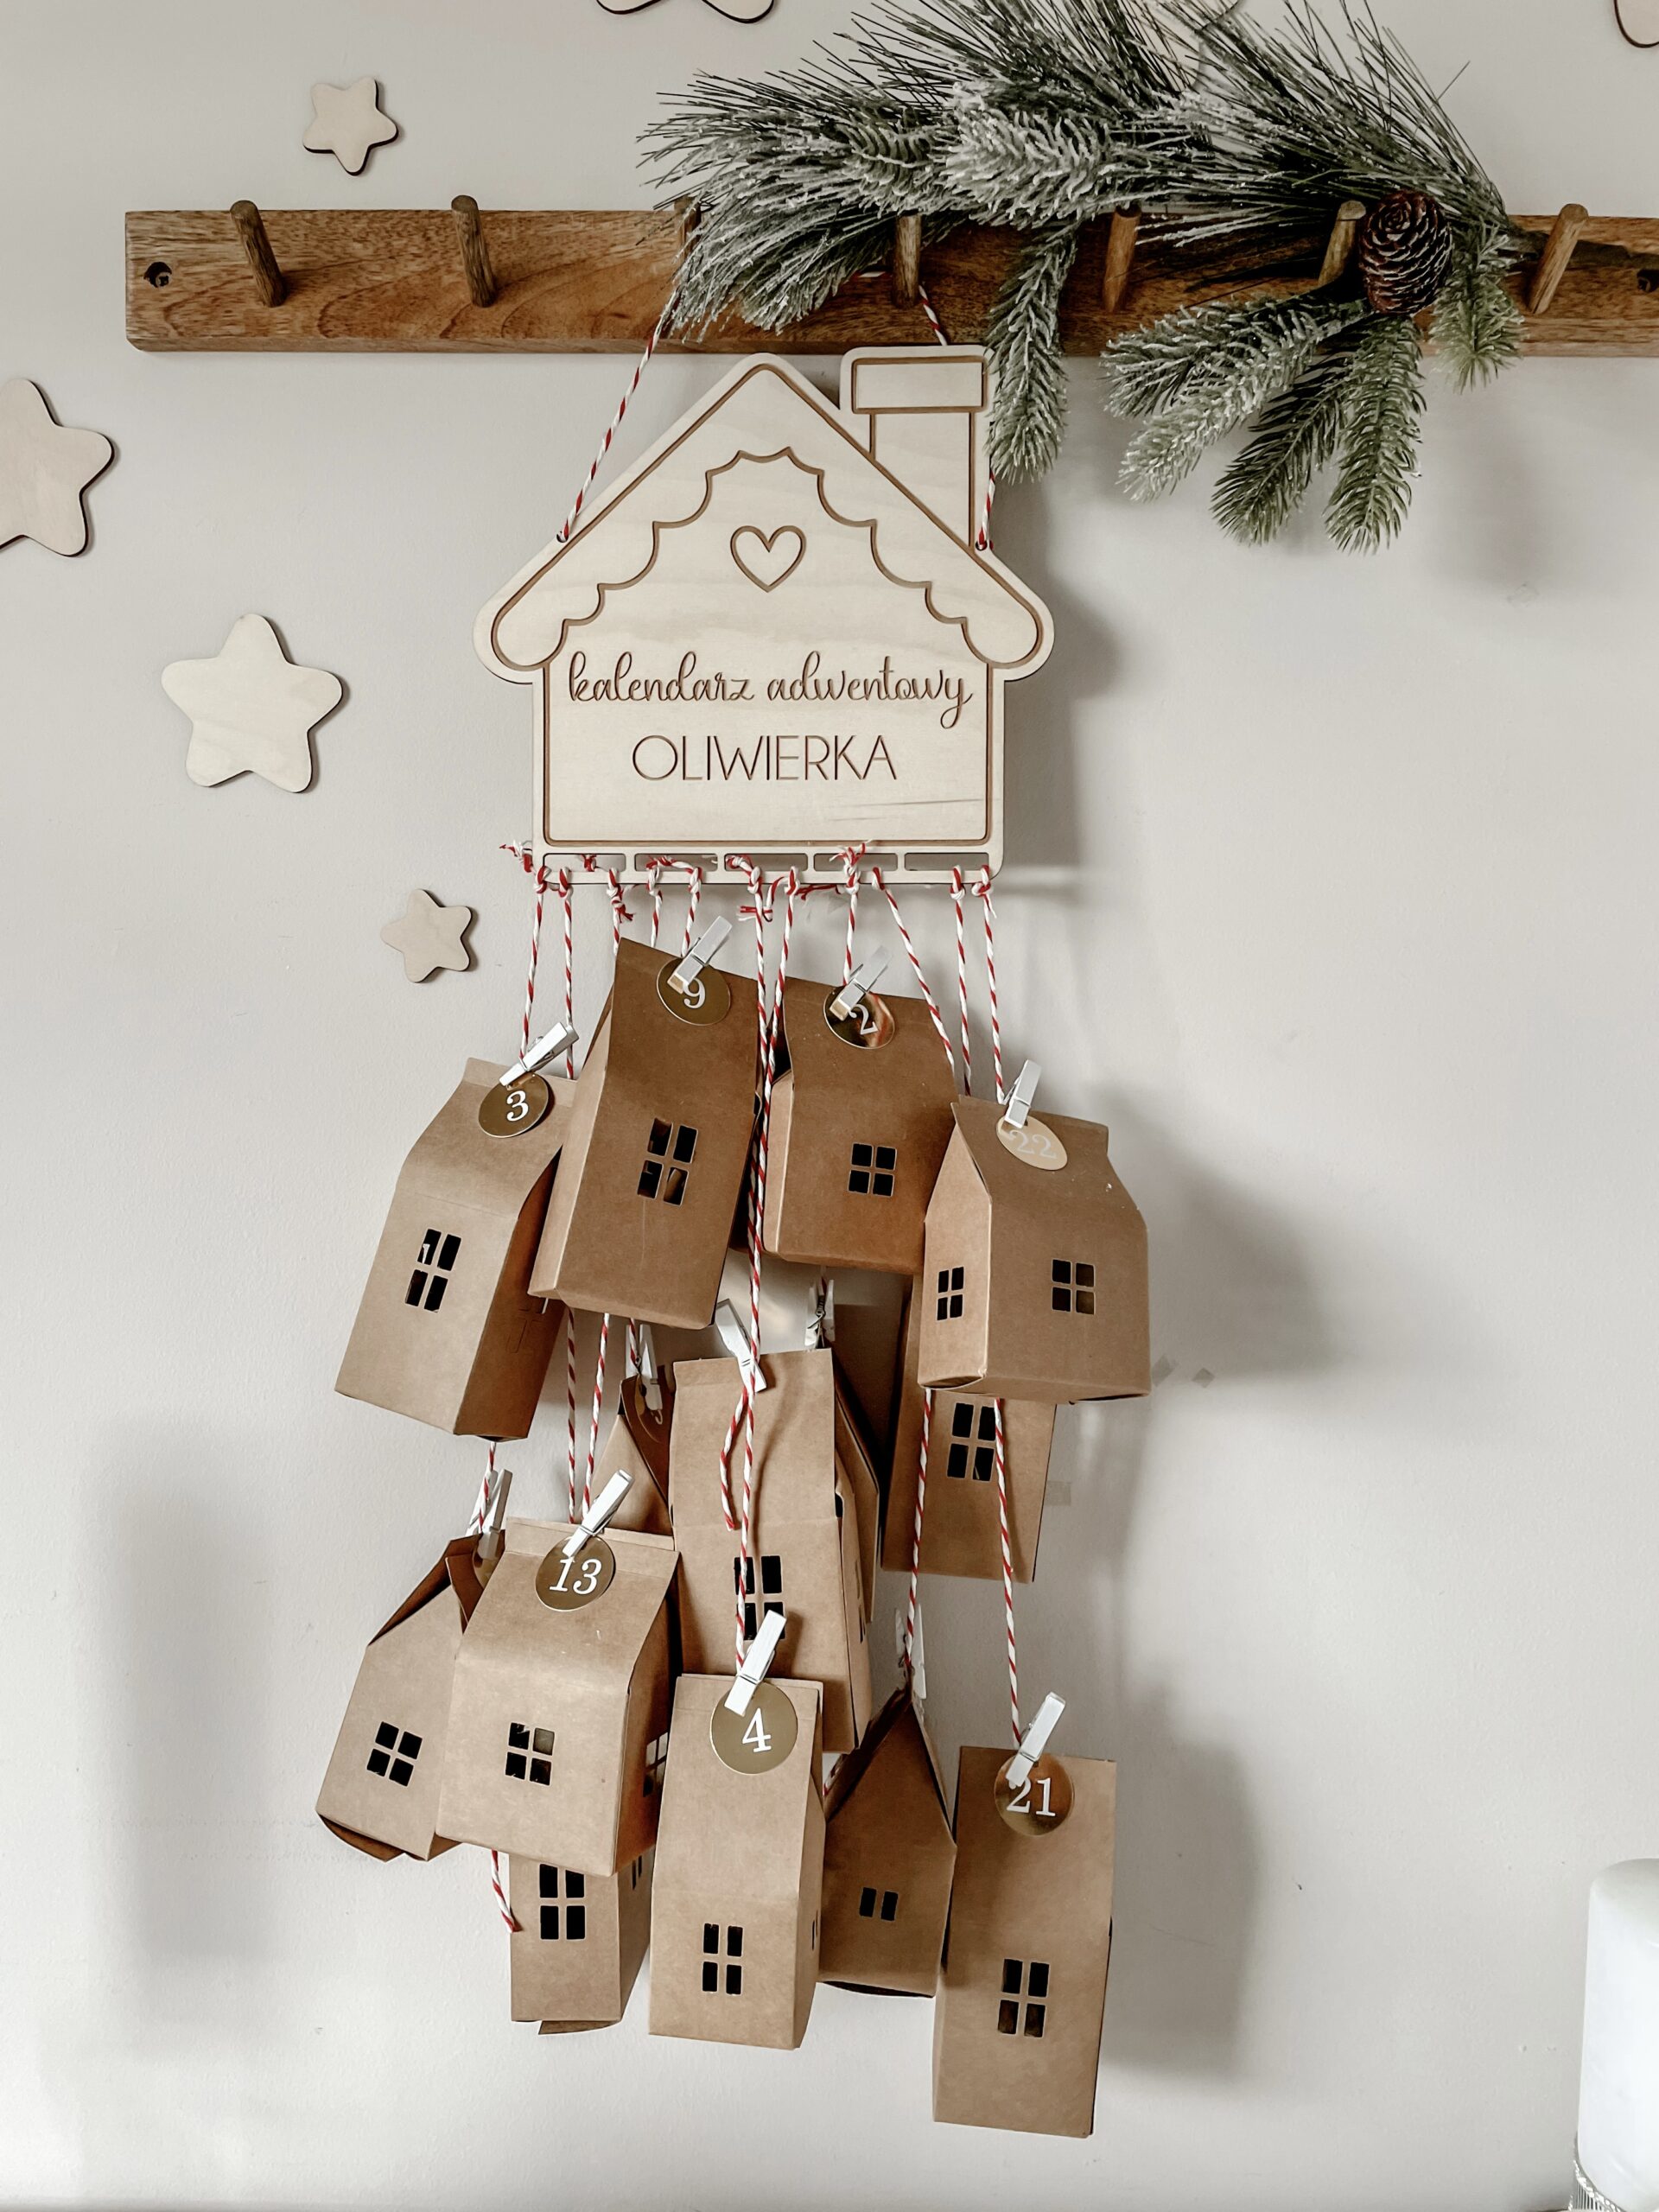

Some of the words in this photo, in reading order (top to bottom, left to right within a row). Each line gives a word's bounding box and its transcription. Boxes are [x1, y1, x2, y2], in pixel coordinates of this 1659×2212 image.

[568, 651, 755, 702] kalendarz
[766, 650, 974, 729] adwentowy
[632, 734, 898, 781] OLIWIERKA
[682, 977, 706, 1009] 9
[849, 1003, 879, 1035] 2
[506, 1090, 529, 1122] 3
[1008, 1129, 1058, 1160] 22
[549, 1556, 602, 1595] 13
[742, 1707, 772, 1752] 4
[1006, 1777, 1056, 1817] 21
